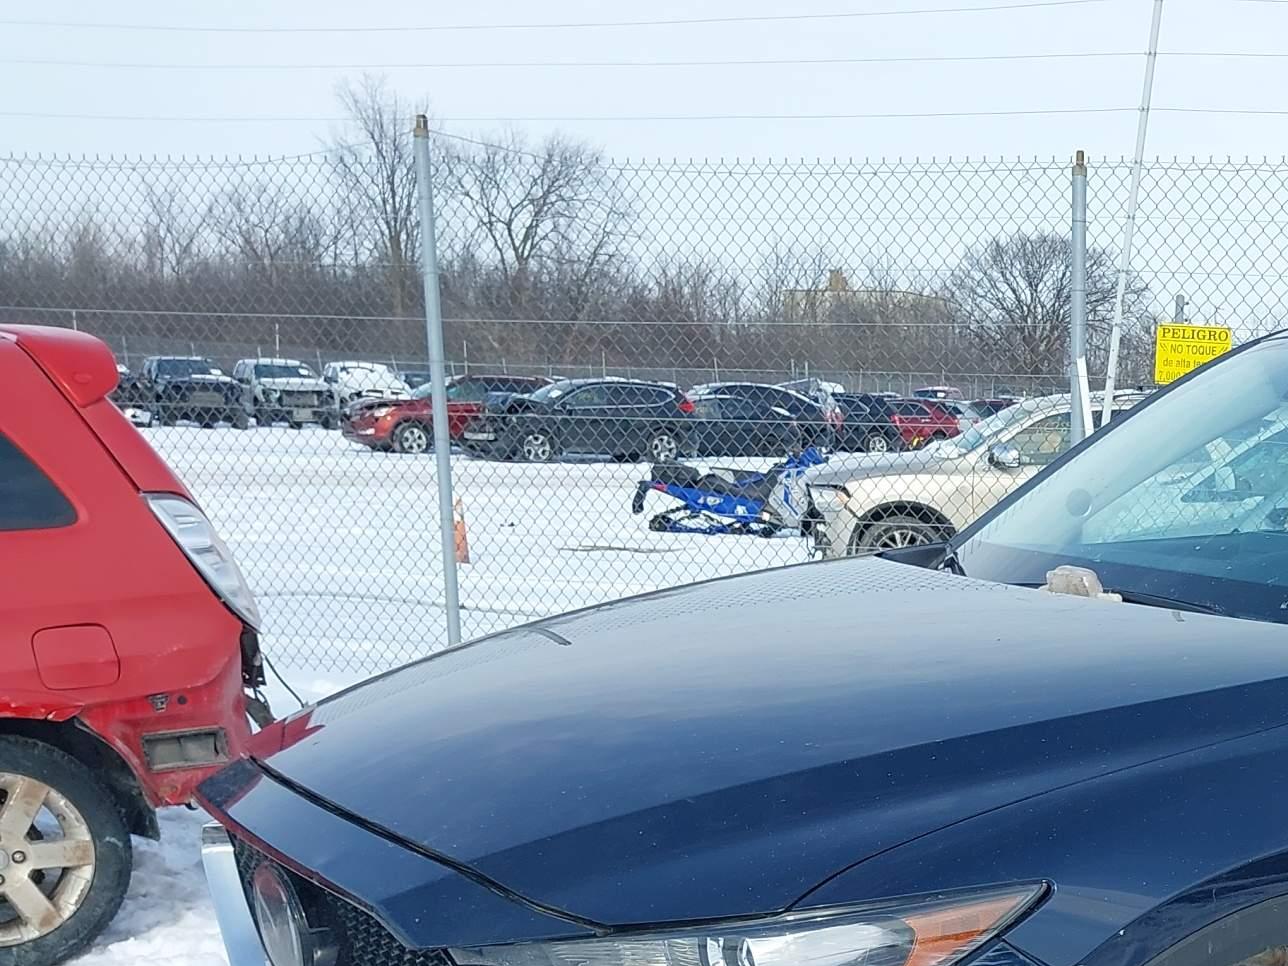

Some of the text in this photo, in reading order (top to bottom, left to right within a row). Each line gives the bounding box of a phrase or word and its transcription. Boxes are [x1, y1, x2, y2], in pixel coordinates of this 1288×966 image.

[1162, 327, 1229, 342] PELIGRO
[1170, 343, 1217, 356] NO TOQUE
[1163, 358, 1173, 368] de
